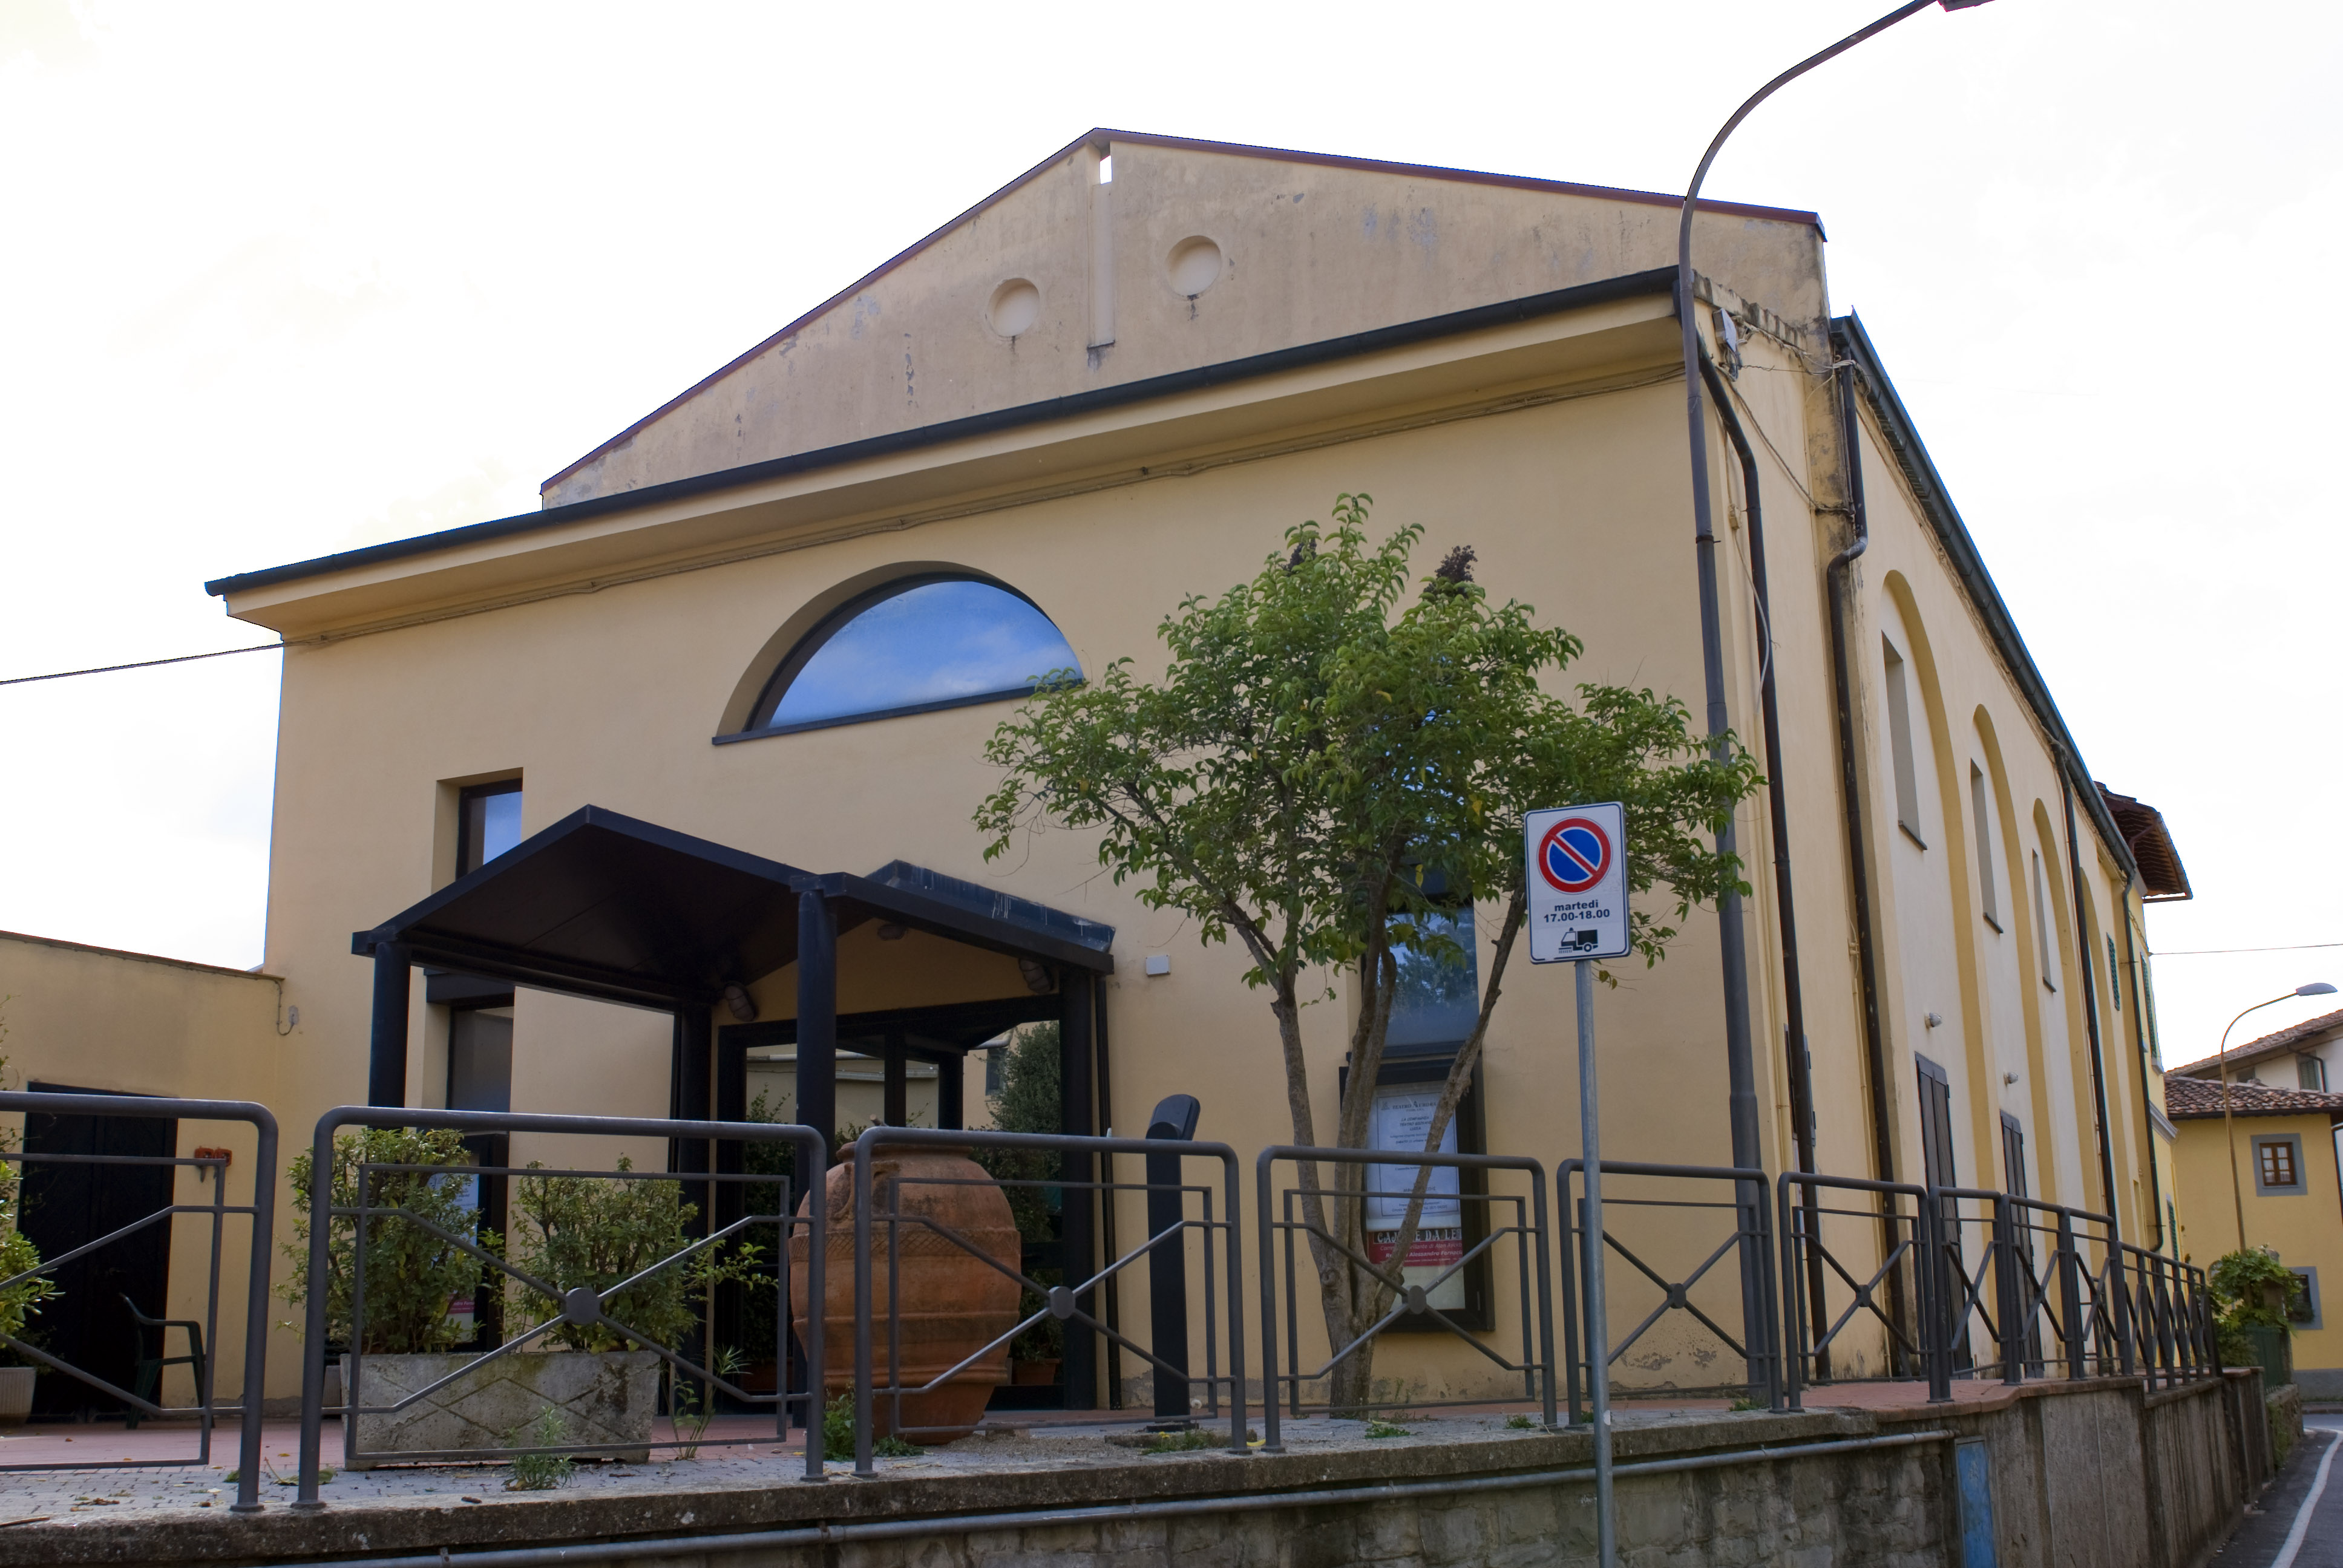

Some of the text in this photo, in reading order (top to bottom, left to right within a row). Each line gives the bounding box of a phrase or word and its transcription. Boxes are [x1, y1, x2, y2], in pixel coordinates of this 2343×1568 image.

[1554, 900, 1599, 912] martedi
[1544, 909, 1610, 923] 17.00-18.00
[1425, 1229, 1440, 1241] DA
